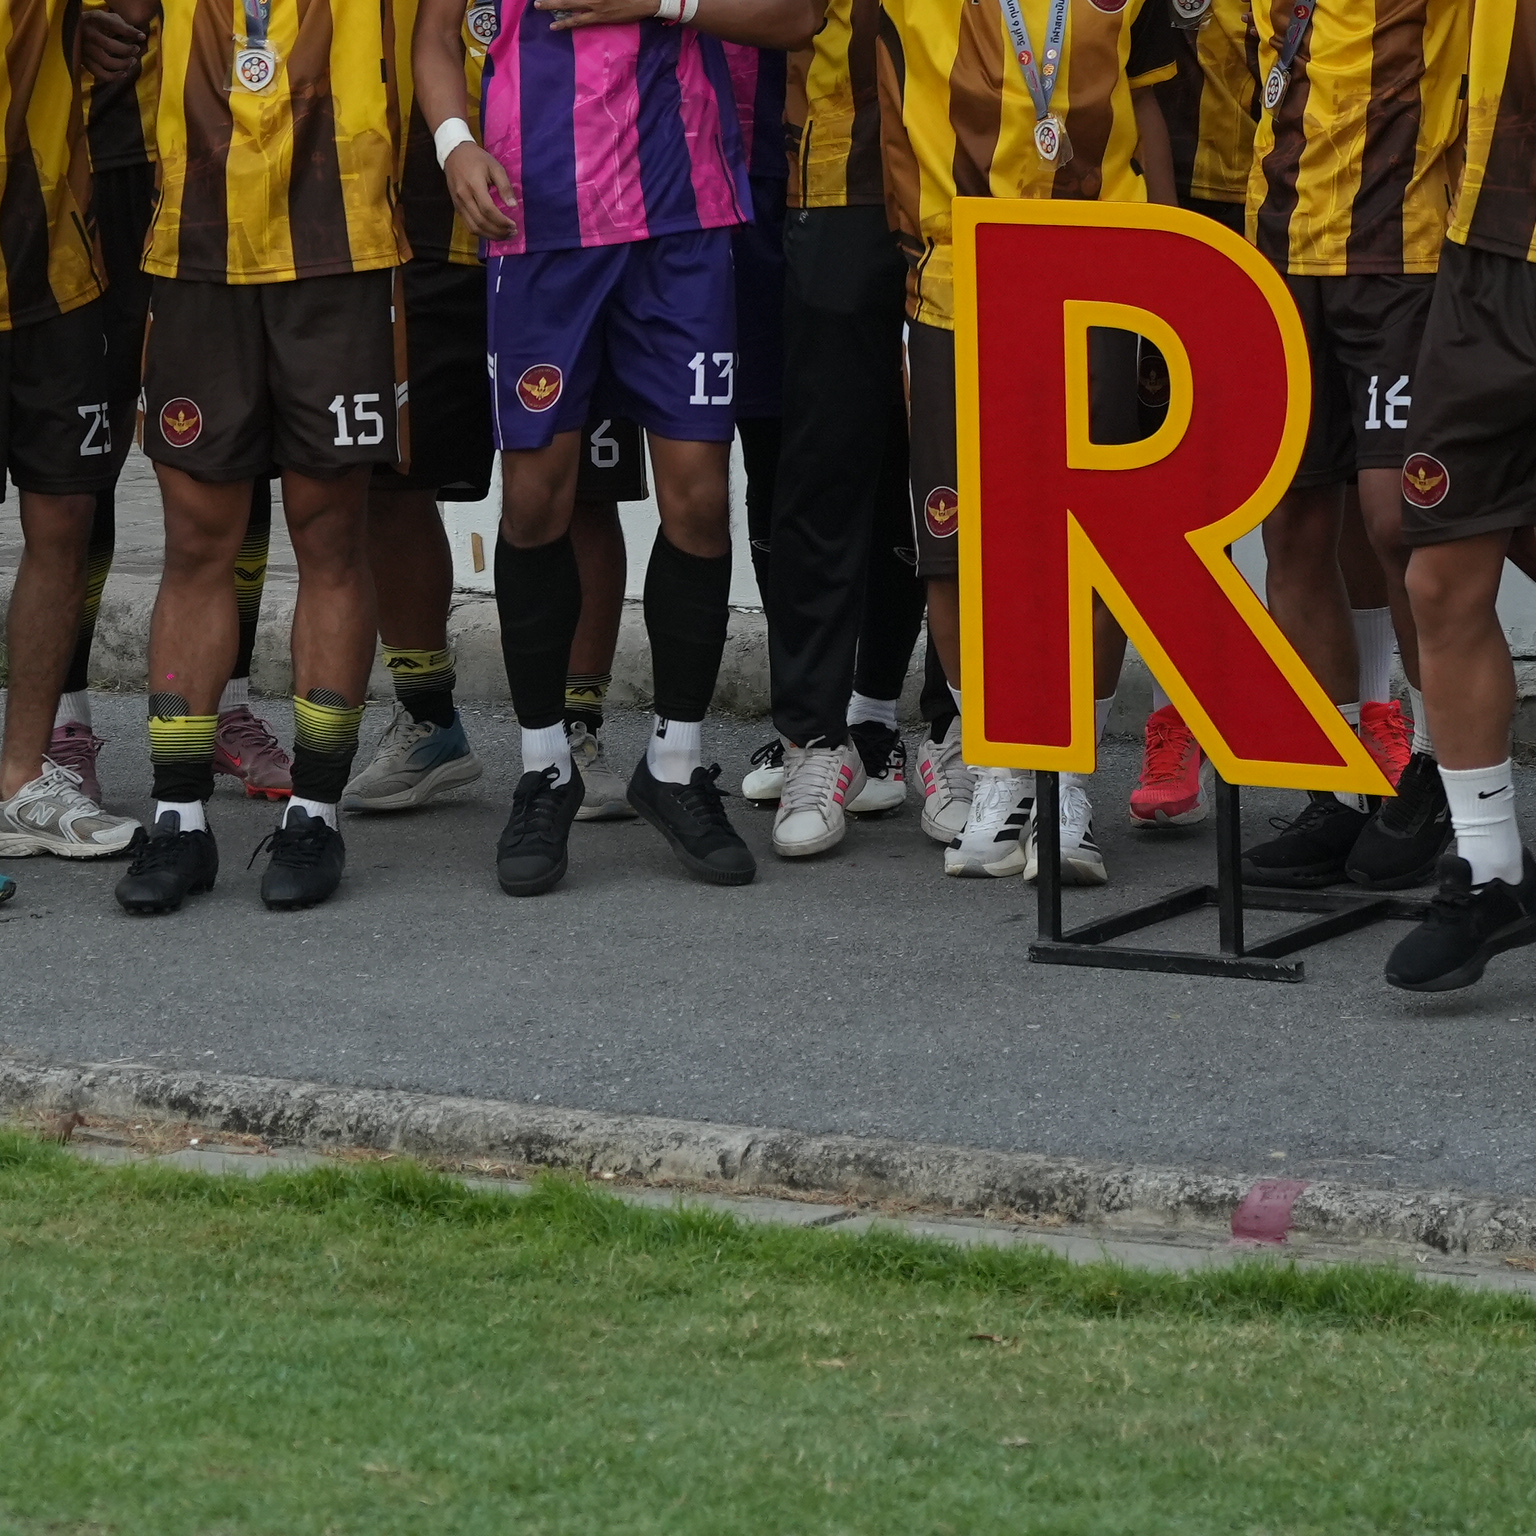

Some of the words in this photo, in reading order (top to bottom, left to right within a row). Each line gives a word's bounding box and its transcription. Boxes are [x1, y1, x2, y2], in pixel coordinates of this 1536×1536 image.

[1010, 27, 1026, 48] วันที่
[688, 351, 735, 406] 13
[1364, 375, 1411, 430] 16
[332, 393, 385, 447] 15
[952, 196, 1398, 797] R
